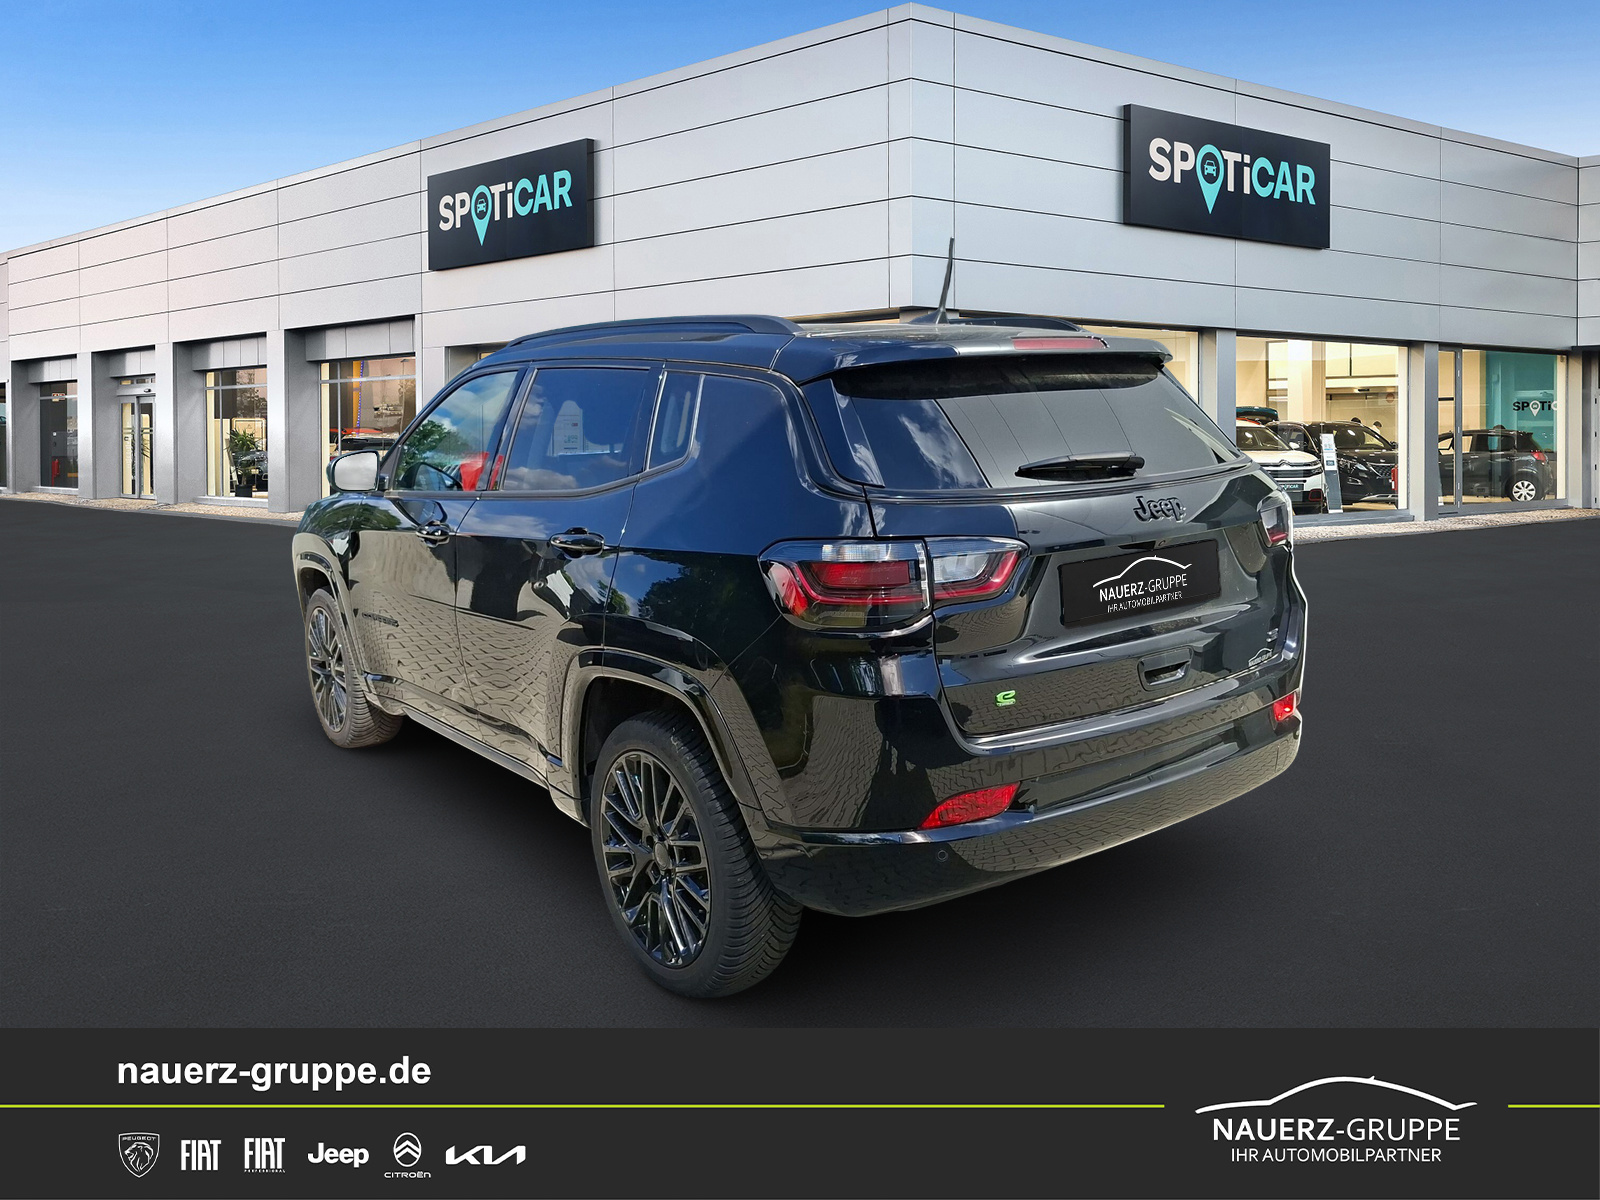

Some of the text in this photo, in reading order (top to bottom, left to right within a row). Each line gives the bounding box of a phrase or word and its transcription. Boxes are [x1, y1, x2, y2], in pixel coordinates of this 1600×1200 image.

[1133, 495, 1186, 522] Jeep
[1099, 573, 1188, 602] NAUERZ-GRUPPE
[1107, 590, 1183, 613] IHR AUTOMOBILPARTNER
